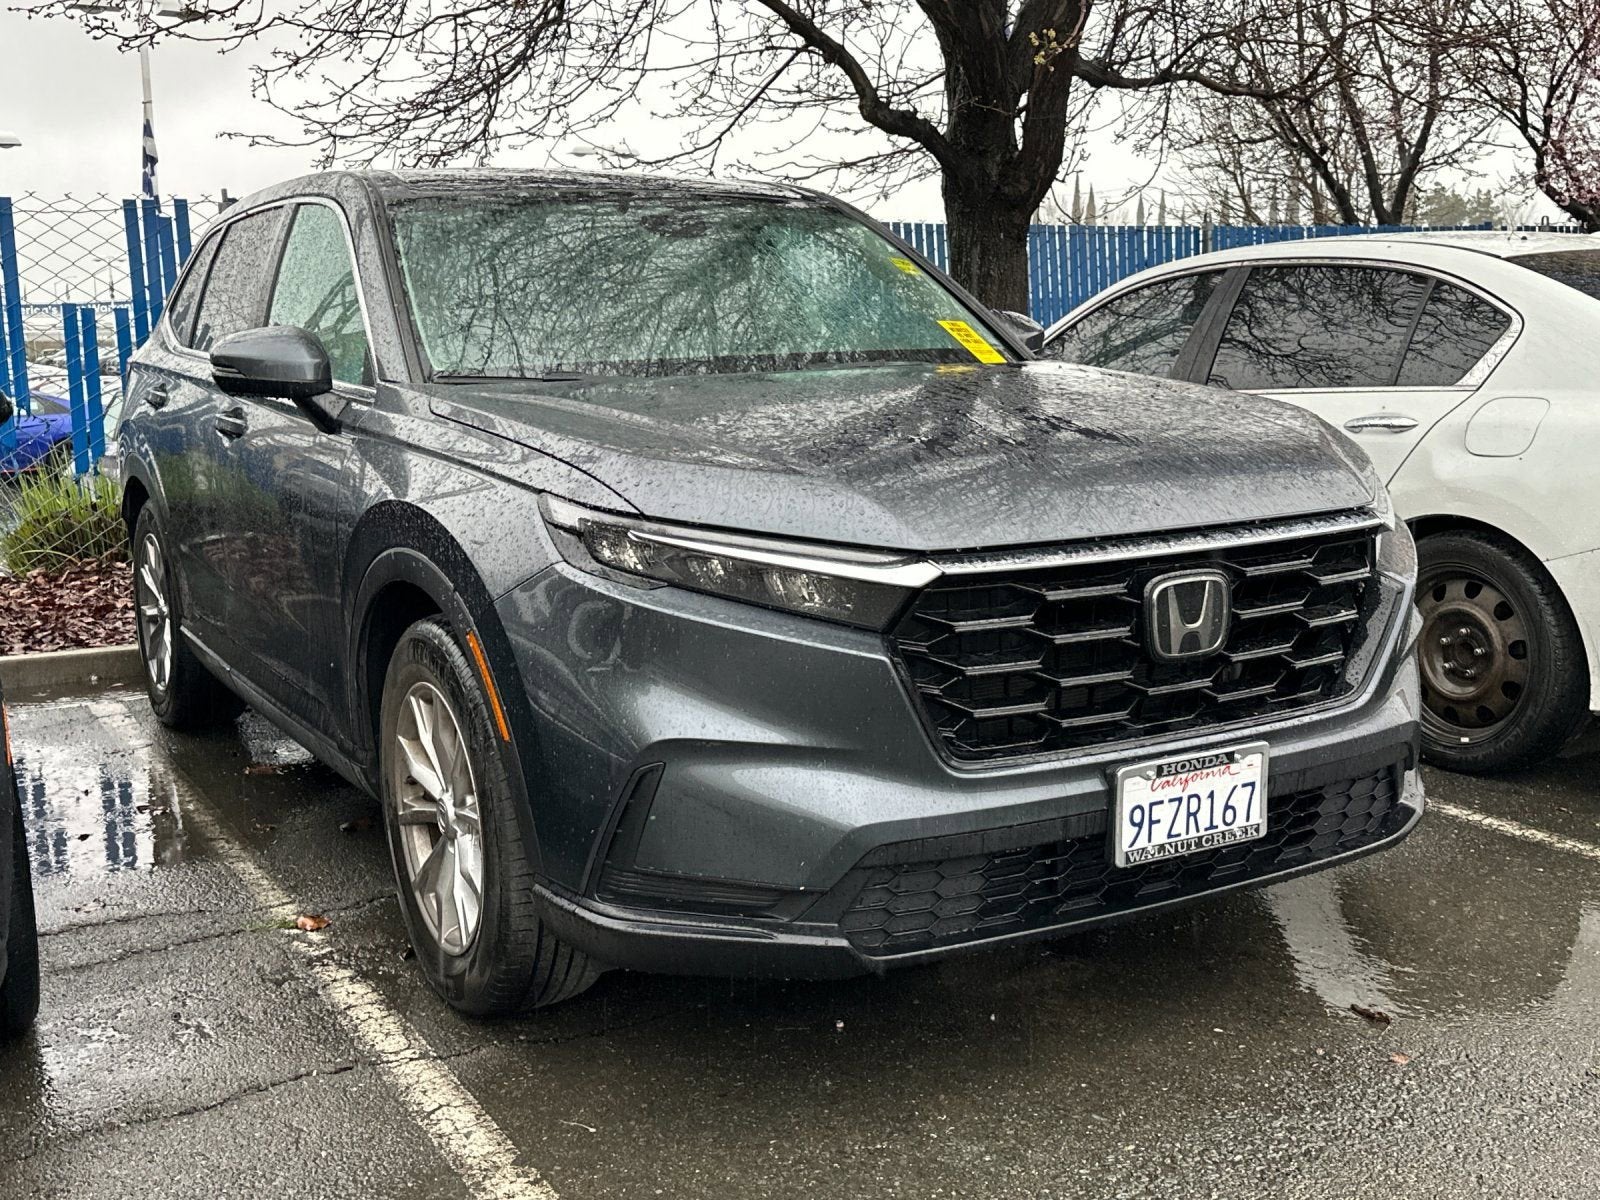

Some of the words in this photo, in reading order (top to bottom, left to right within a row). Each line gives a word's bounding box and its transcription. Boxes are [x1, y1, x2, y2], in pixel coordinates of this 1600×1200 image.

[1150, 764, 1241, 793] California
[1161, 754, 1229, 776] HONDA
[1127, 781, 1256, 849] 9FZR167
[1127, 839, 1199, 863] WALNUT
[1202, 825, 1259, 847] CREEK
